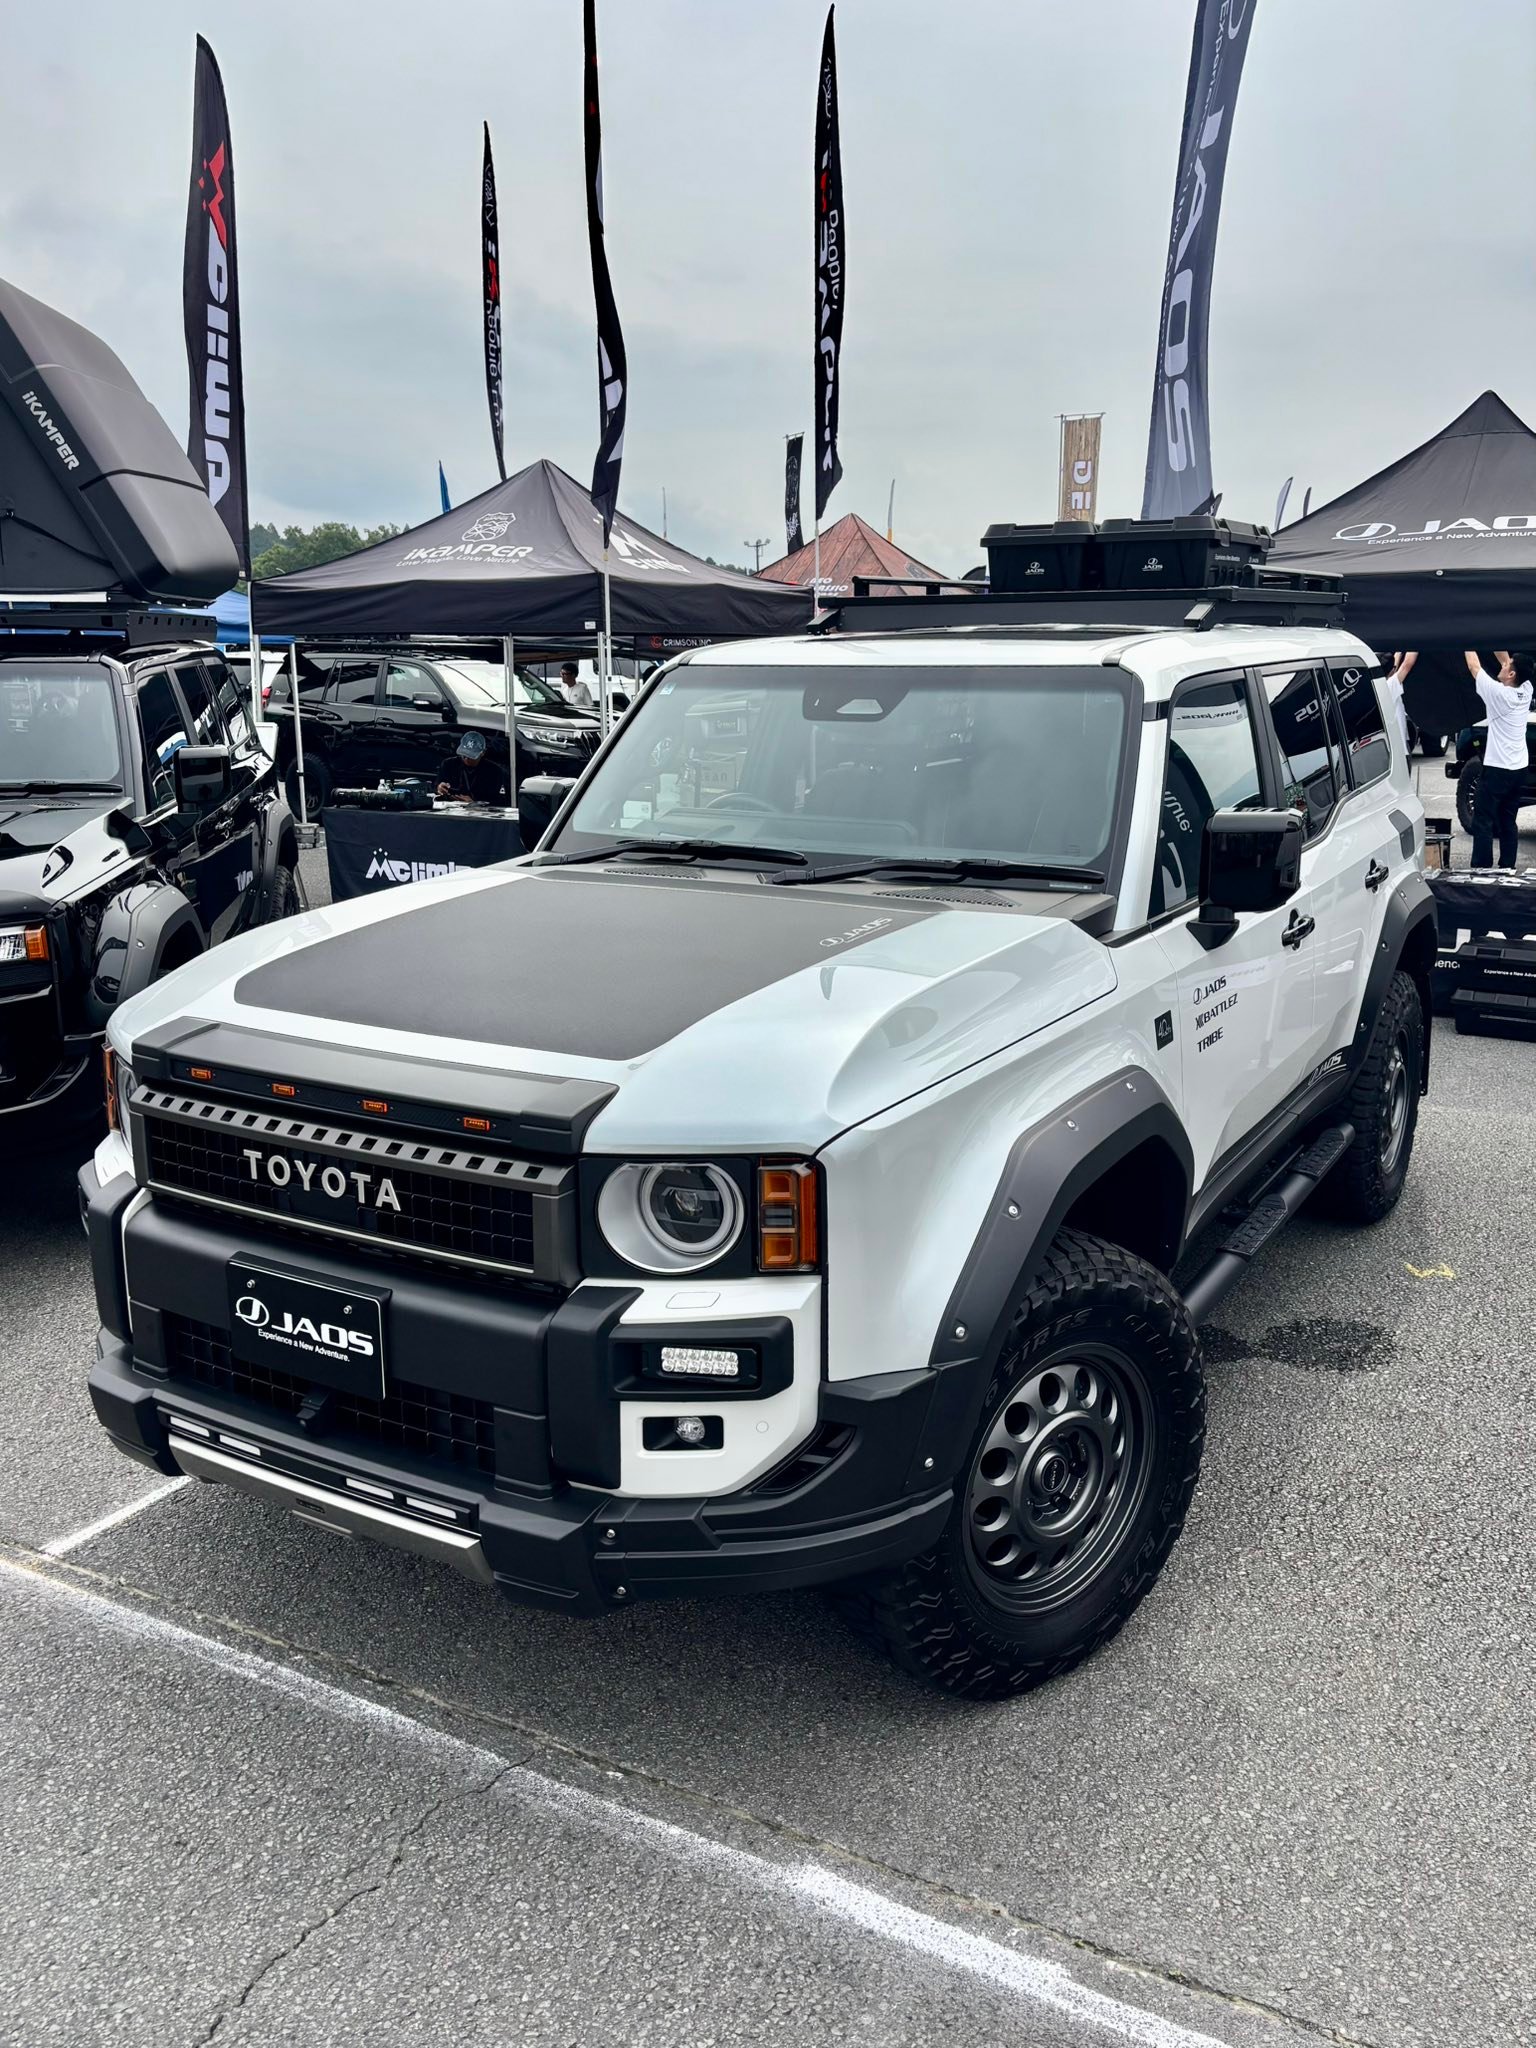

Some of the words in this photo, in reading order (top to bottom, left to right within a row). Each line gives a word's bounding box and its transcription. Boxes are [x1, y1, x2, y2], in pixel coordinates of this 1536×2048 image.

[1071, 460, 1092, 521] DE
[1368, 535, 1432, 545] Experience
[1446, 532, 1474, 540] New
[456, 555, 483, 563] Love
[1203, 975, 1227, 1000] JAOS
[1197, 1026, 1224, 1053] TRIBE
[243, 1149, 401, 1212] TOYOTA
[258, 1328, 293, 1347] Experience
[299, 1340, 314, 1352] New
[271, 1312, 374, 1356] JAOS
